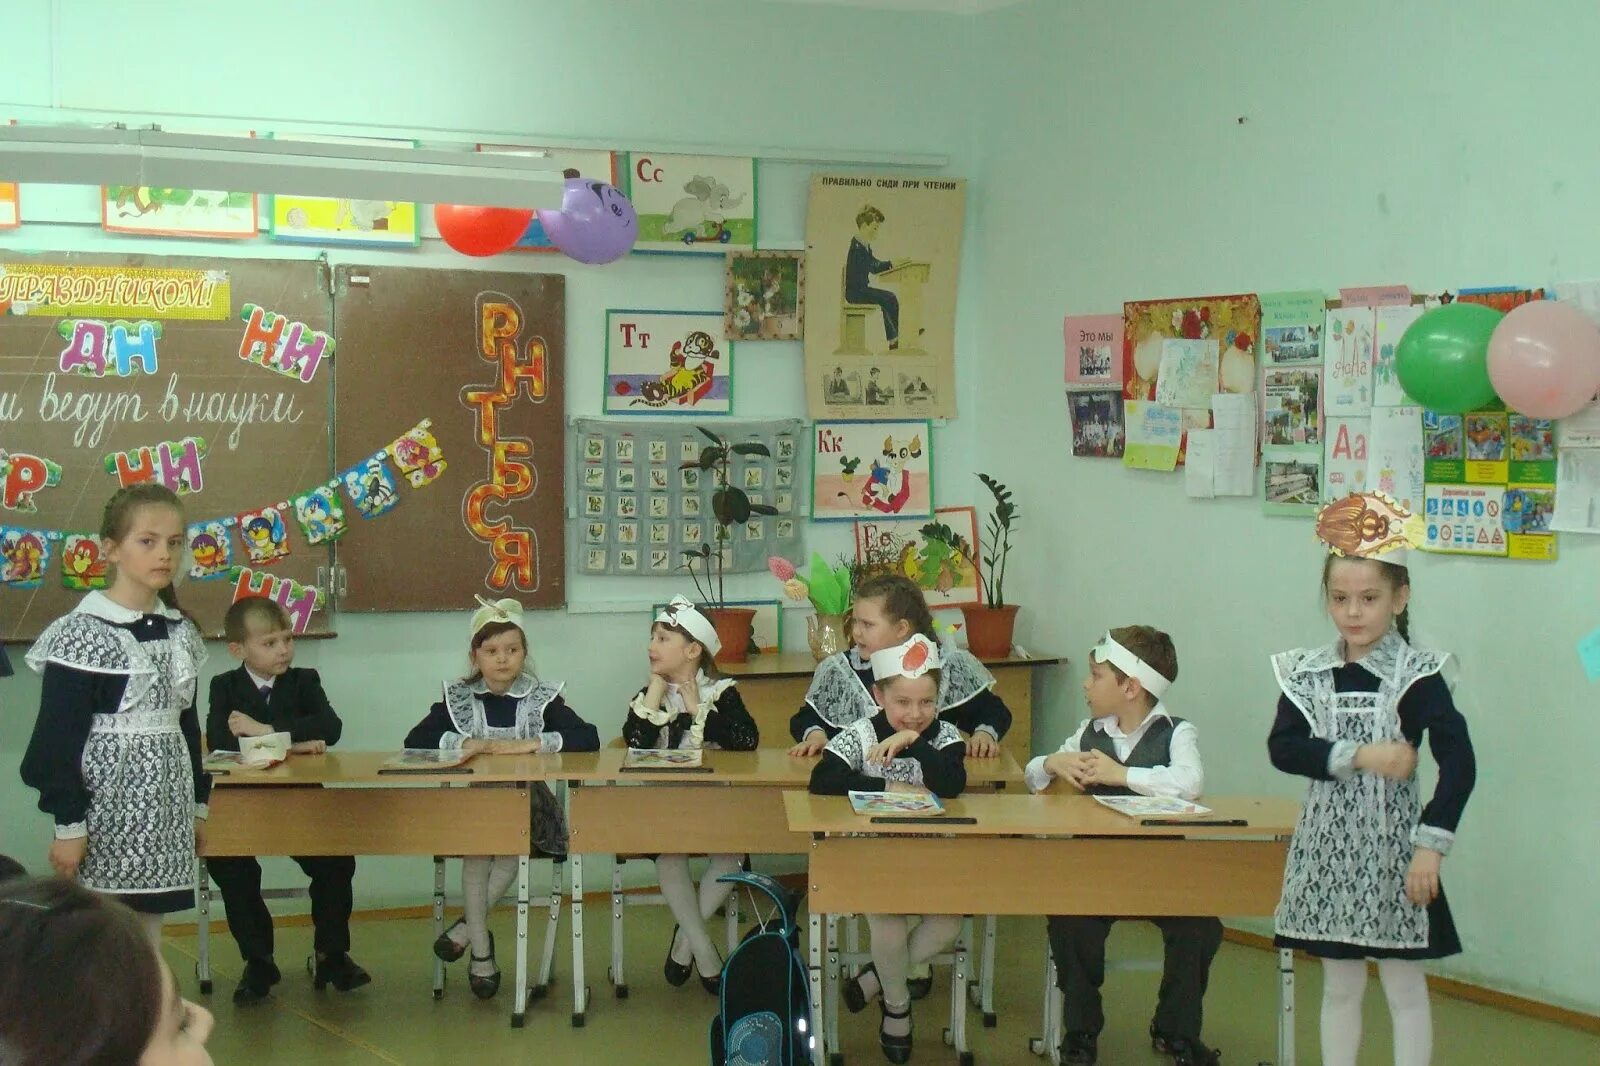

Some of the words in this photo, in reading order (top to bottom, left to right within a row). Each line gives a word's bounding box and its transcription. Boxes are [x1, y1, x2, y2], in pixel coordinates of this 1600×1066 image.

[636, 158, 664, 183] Сс
[822, 177, 872, 187] ПРАВИЛЬНО
[876, 179, 898, 189] СИДИ
[902, 180, 920, 189] ПРИ
[923, 181, 957, 190] ЧТЕНИИ
[0, 274, 216, 312] ПРАЗДНИКОМ!
[59, 319, 158, 377] ДН
[239, 307, 327, 383] НИ
[619, 323, 650, 349] Тт
[1080, 330, 1096, 342] Это
[1098, 332, 1114, 341] мы
[39, 372, 149, 448] ведут
[817, 428, 844, 454] Кк
[3, 453, 48, 509] Р
